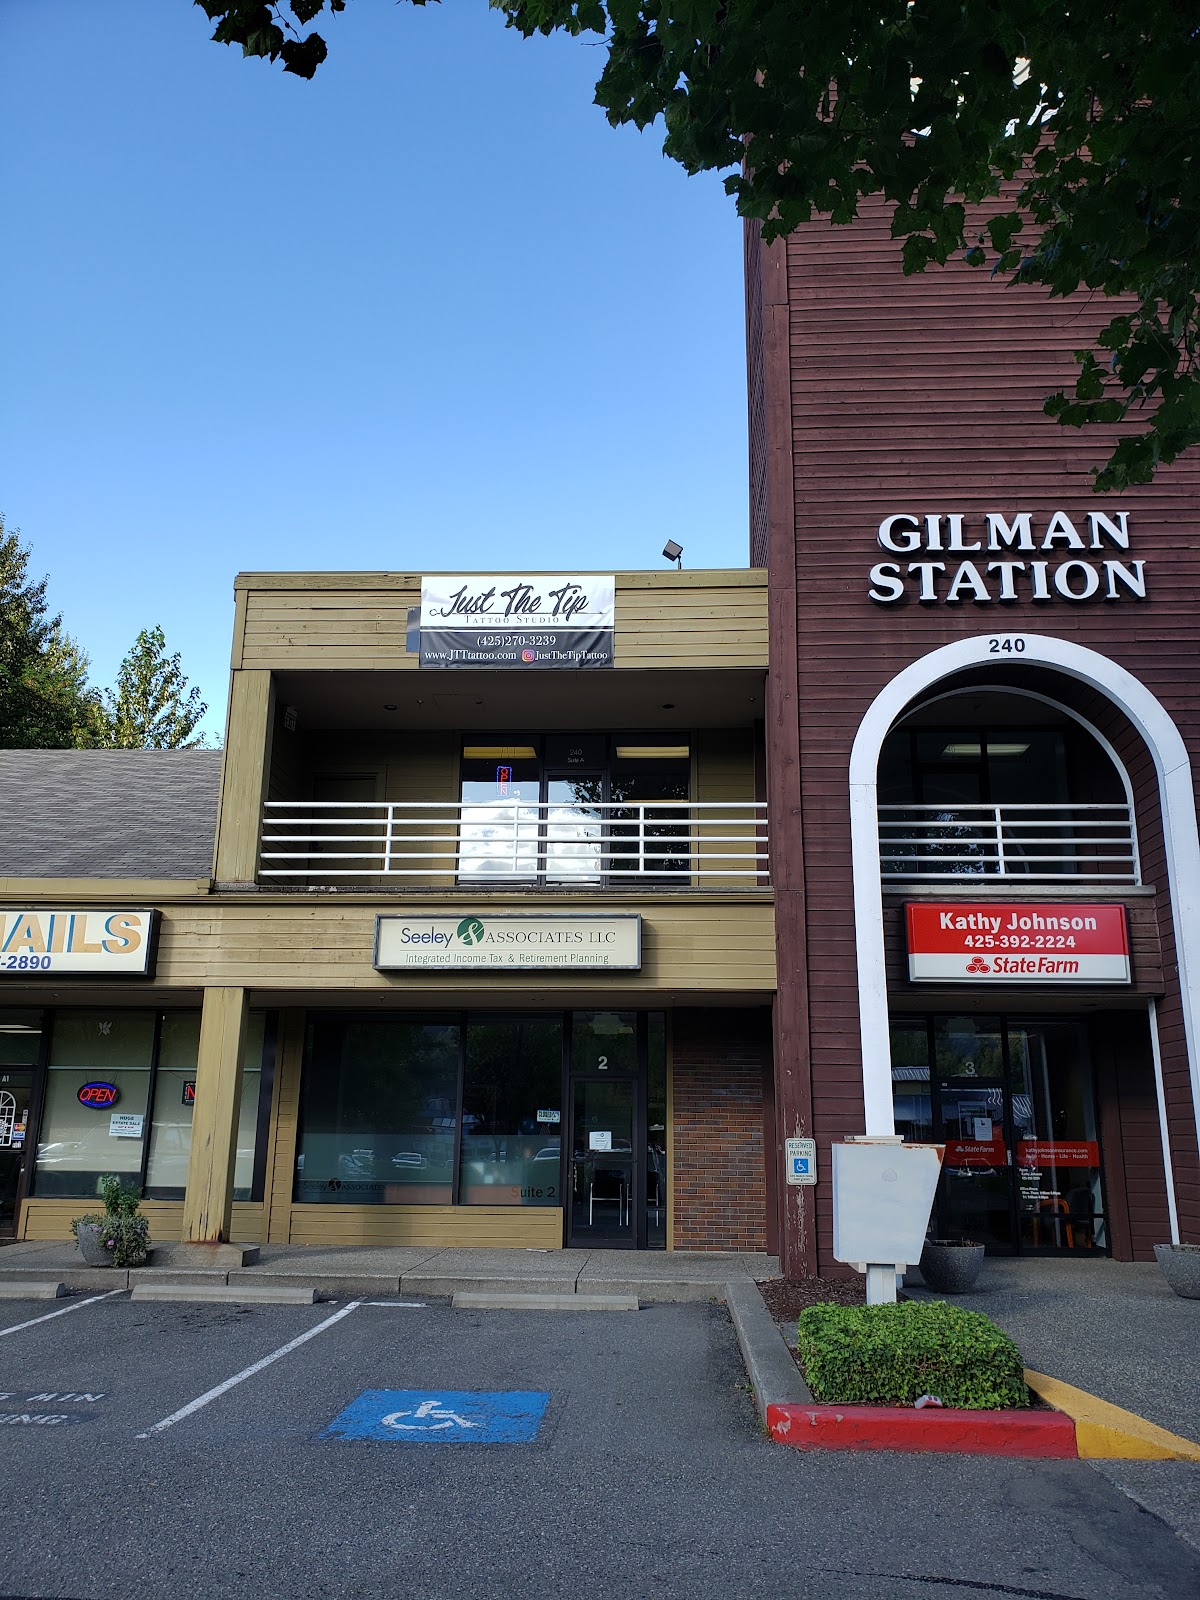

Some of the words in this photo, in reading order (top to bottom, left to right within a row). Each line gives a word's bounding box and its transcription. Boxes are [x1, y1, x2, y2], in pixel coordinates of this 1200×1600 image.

[878, 511, 1130, 552] GILMAN
[868, 560, 1147, 602] STATION
[440, 584, 496, 617] Just
[501, 583, 542, 618] The
[549, 583, 589, 621] Tip
[464, 615, 510, 624] Tattoo
[516, 615, 559, 624] Studio
[477, 635, 556, 647] (425)270-3239
[988, 638, 1026, 653] 240
[424, 649, 517, 660] www.JTTtattoo.com
[535, 650, 608, 661] JustTheTipTattoo
[500, 767, 508, 795] OPEN
[939, 912, 1002, 934] Kathy
[1006, 912, 1097, 930] Johnson
[0, 914, 142, 954] AILS
[400, 926, 454, 948] Seeley
[485, 931, 583, 944] ASSOCIATES
[589, 931, 616, 944] LLC
[964, 935, 1076, 948] 425-392-2224
[405, 953, 451, 965] Integrated
[453, 953, 487, 963] Income
[489, 953, 503, 963] Tax
[508, 953, 515, 963] &
[519, 953, 568, 963] Retirement
[570, 953, 609, 965] Planning
[598, 1056, 608, 1070] 2
[965, 1061, 976, 1075] 3
[2, 1075, 9, 1083] A1
[80, 1088, 116, 1102] OPEN
[511, 1186, 544, 1198] Suite
[547, 1186, 556, 1198] 2
